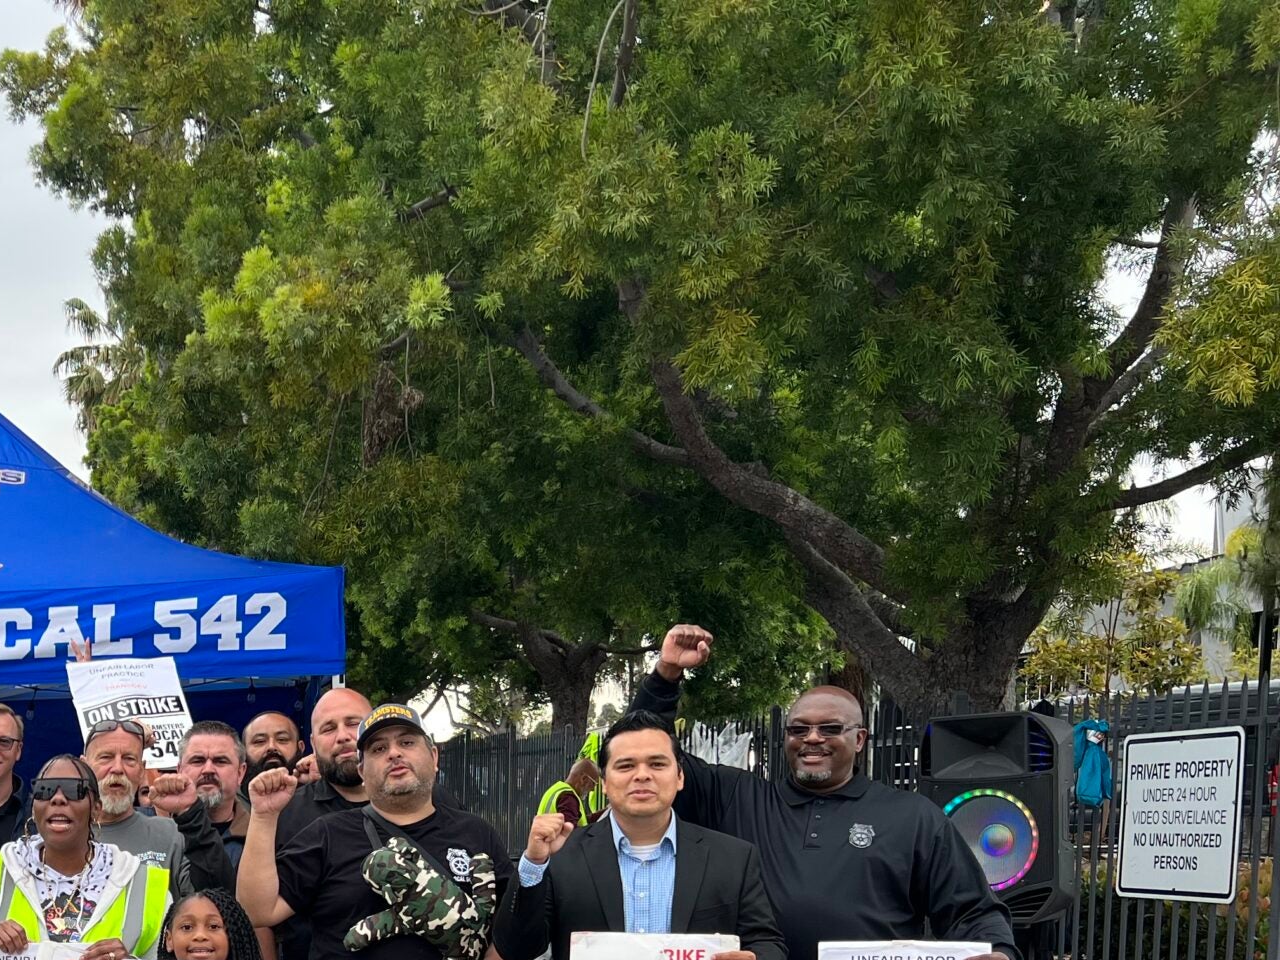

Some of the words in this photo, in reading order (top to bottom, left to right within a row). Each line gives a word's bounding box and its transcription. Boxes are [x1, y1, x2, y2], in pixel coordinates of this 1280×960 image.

[153, 592, 287, 654] 542
[88, 705, 114, 725] ON
[116, 696, 180, 717] STRIKE
[147, 722, 185, 730] AMSTERS
[152, 729, 184, 740] OCAL
[150, 741, 179, 758] 54
[1130, 763, 1171, 780] PRIVATE
[1175, 759, 1233, 778] PROPERTY
[1142, 788, 1174, 802] UNDER
[1176, 787, 1187, 800] 24
[1189, 786, 1217, 801] HOUR
[1132, 810, 1159, 824] VIDEO
[1161, 810, 1227, 824] SURVEILANCE
[1133, 833, 1146, 847] NO
[1149, 833, 1222, 848] UNAUTHORIZED
[1153, 855, 1198, 870] PERSONS
